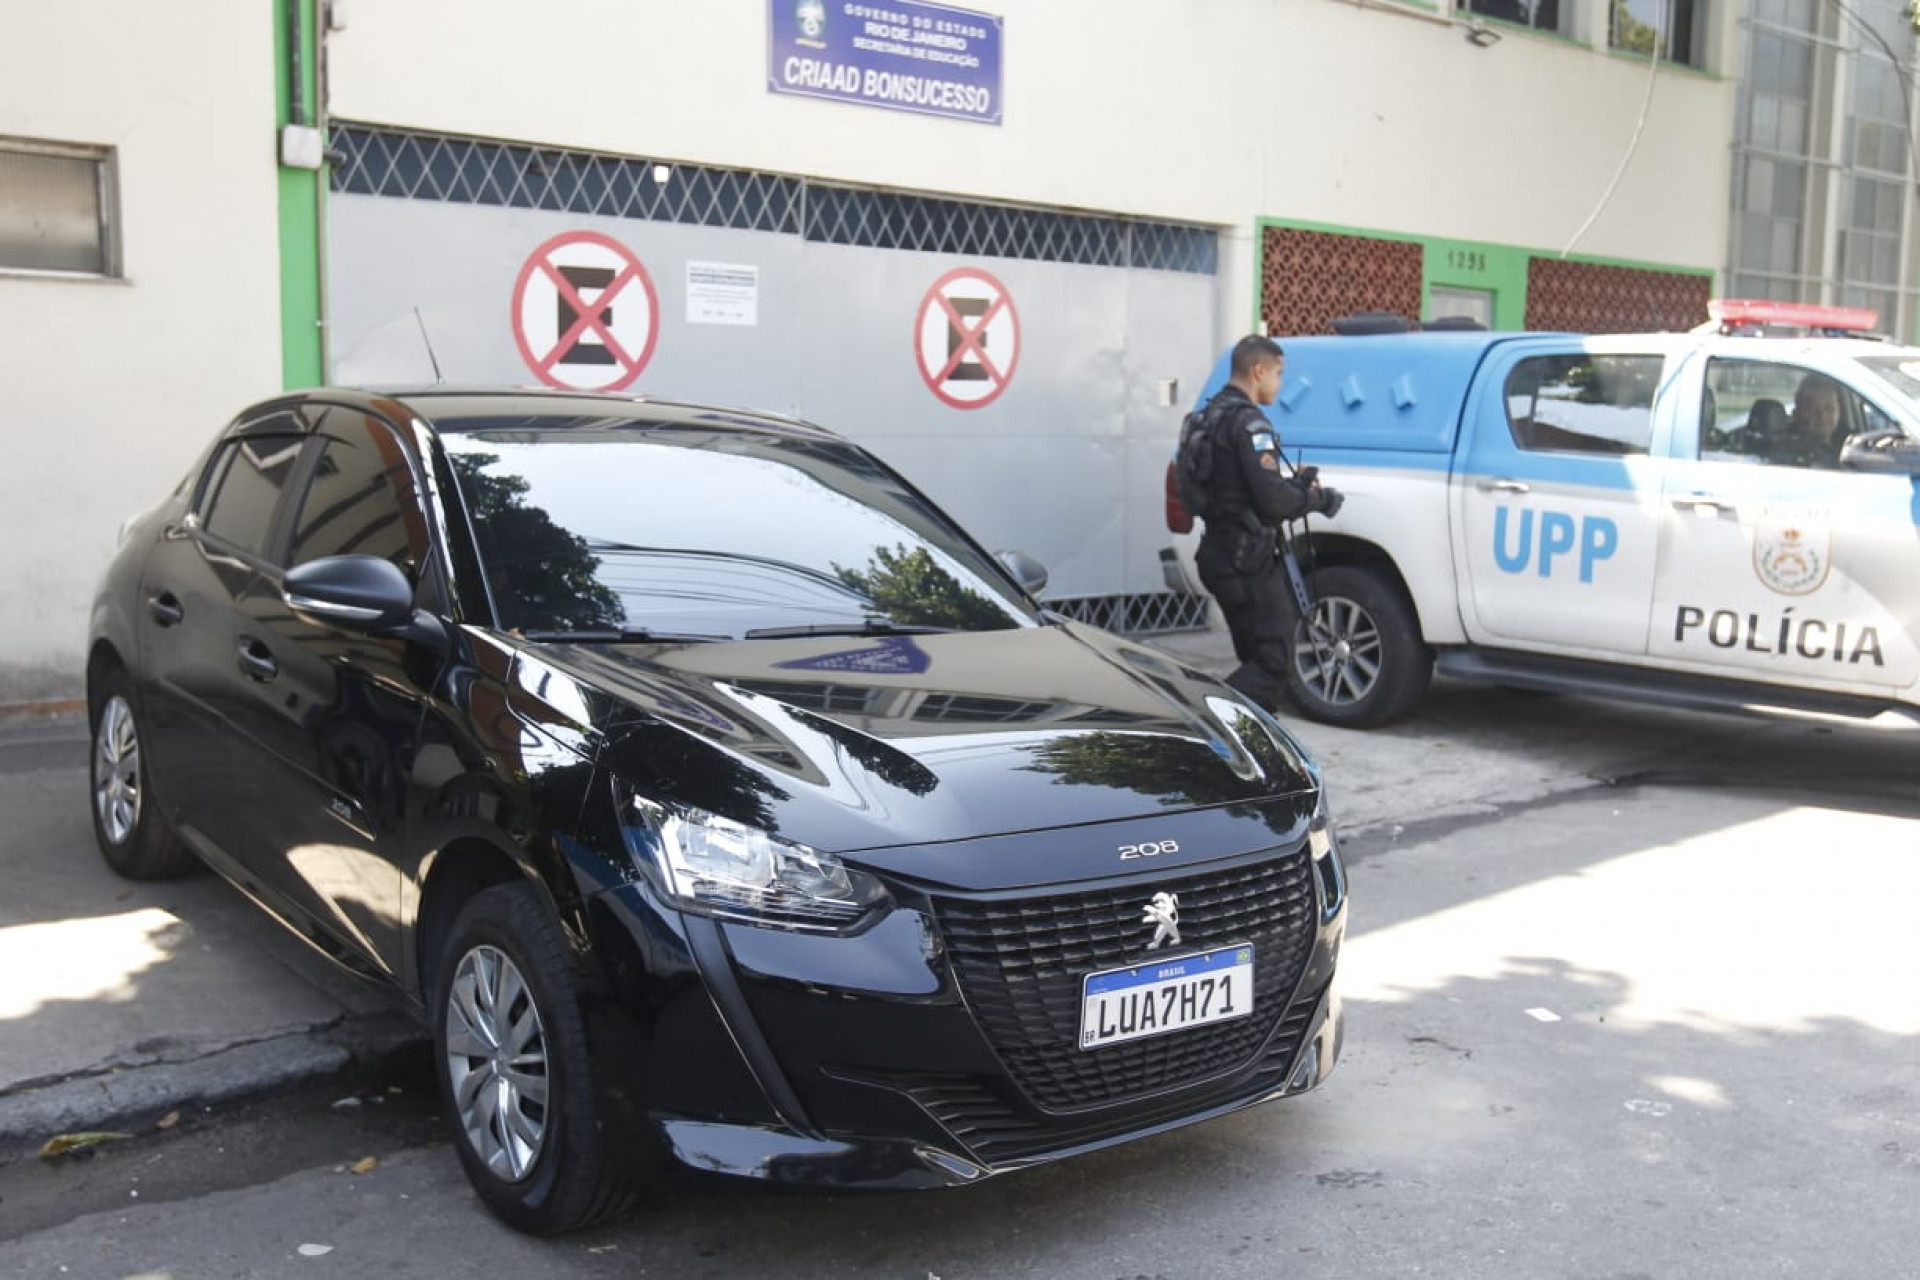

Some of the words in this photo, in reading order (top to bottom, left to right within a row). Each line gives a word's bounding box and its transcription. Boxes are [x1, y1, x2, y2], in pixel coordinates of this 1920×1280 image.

[843, 3, 909, 26] GOVERNO
[912, 16, 932, 29] DO
[936, 20, 987, 39] ESTADO
[865, 21, 889, 38] RIO
[890, 26, 910, 42] DE
[911, 30, 967, 50] JANEIRO
[784, 55, 861, 93] CRIAAD
[863, 68, 990, 114] BONSUCESSO
[1493, 505, 1618, 583] UPP
[1674, 604, 1885, 667] POLÍCIA
[1118, 840, 1179, 860] 208
[1158, 965, 1186, 979] BRASIL
[1098, 975, 1234, 1039] LUA7H71
